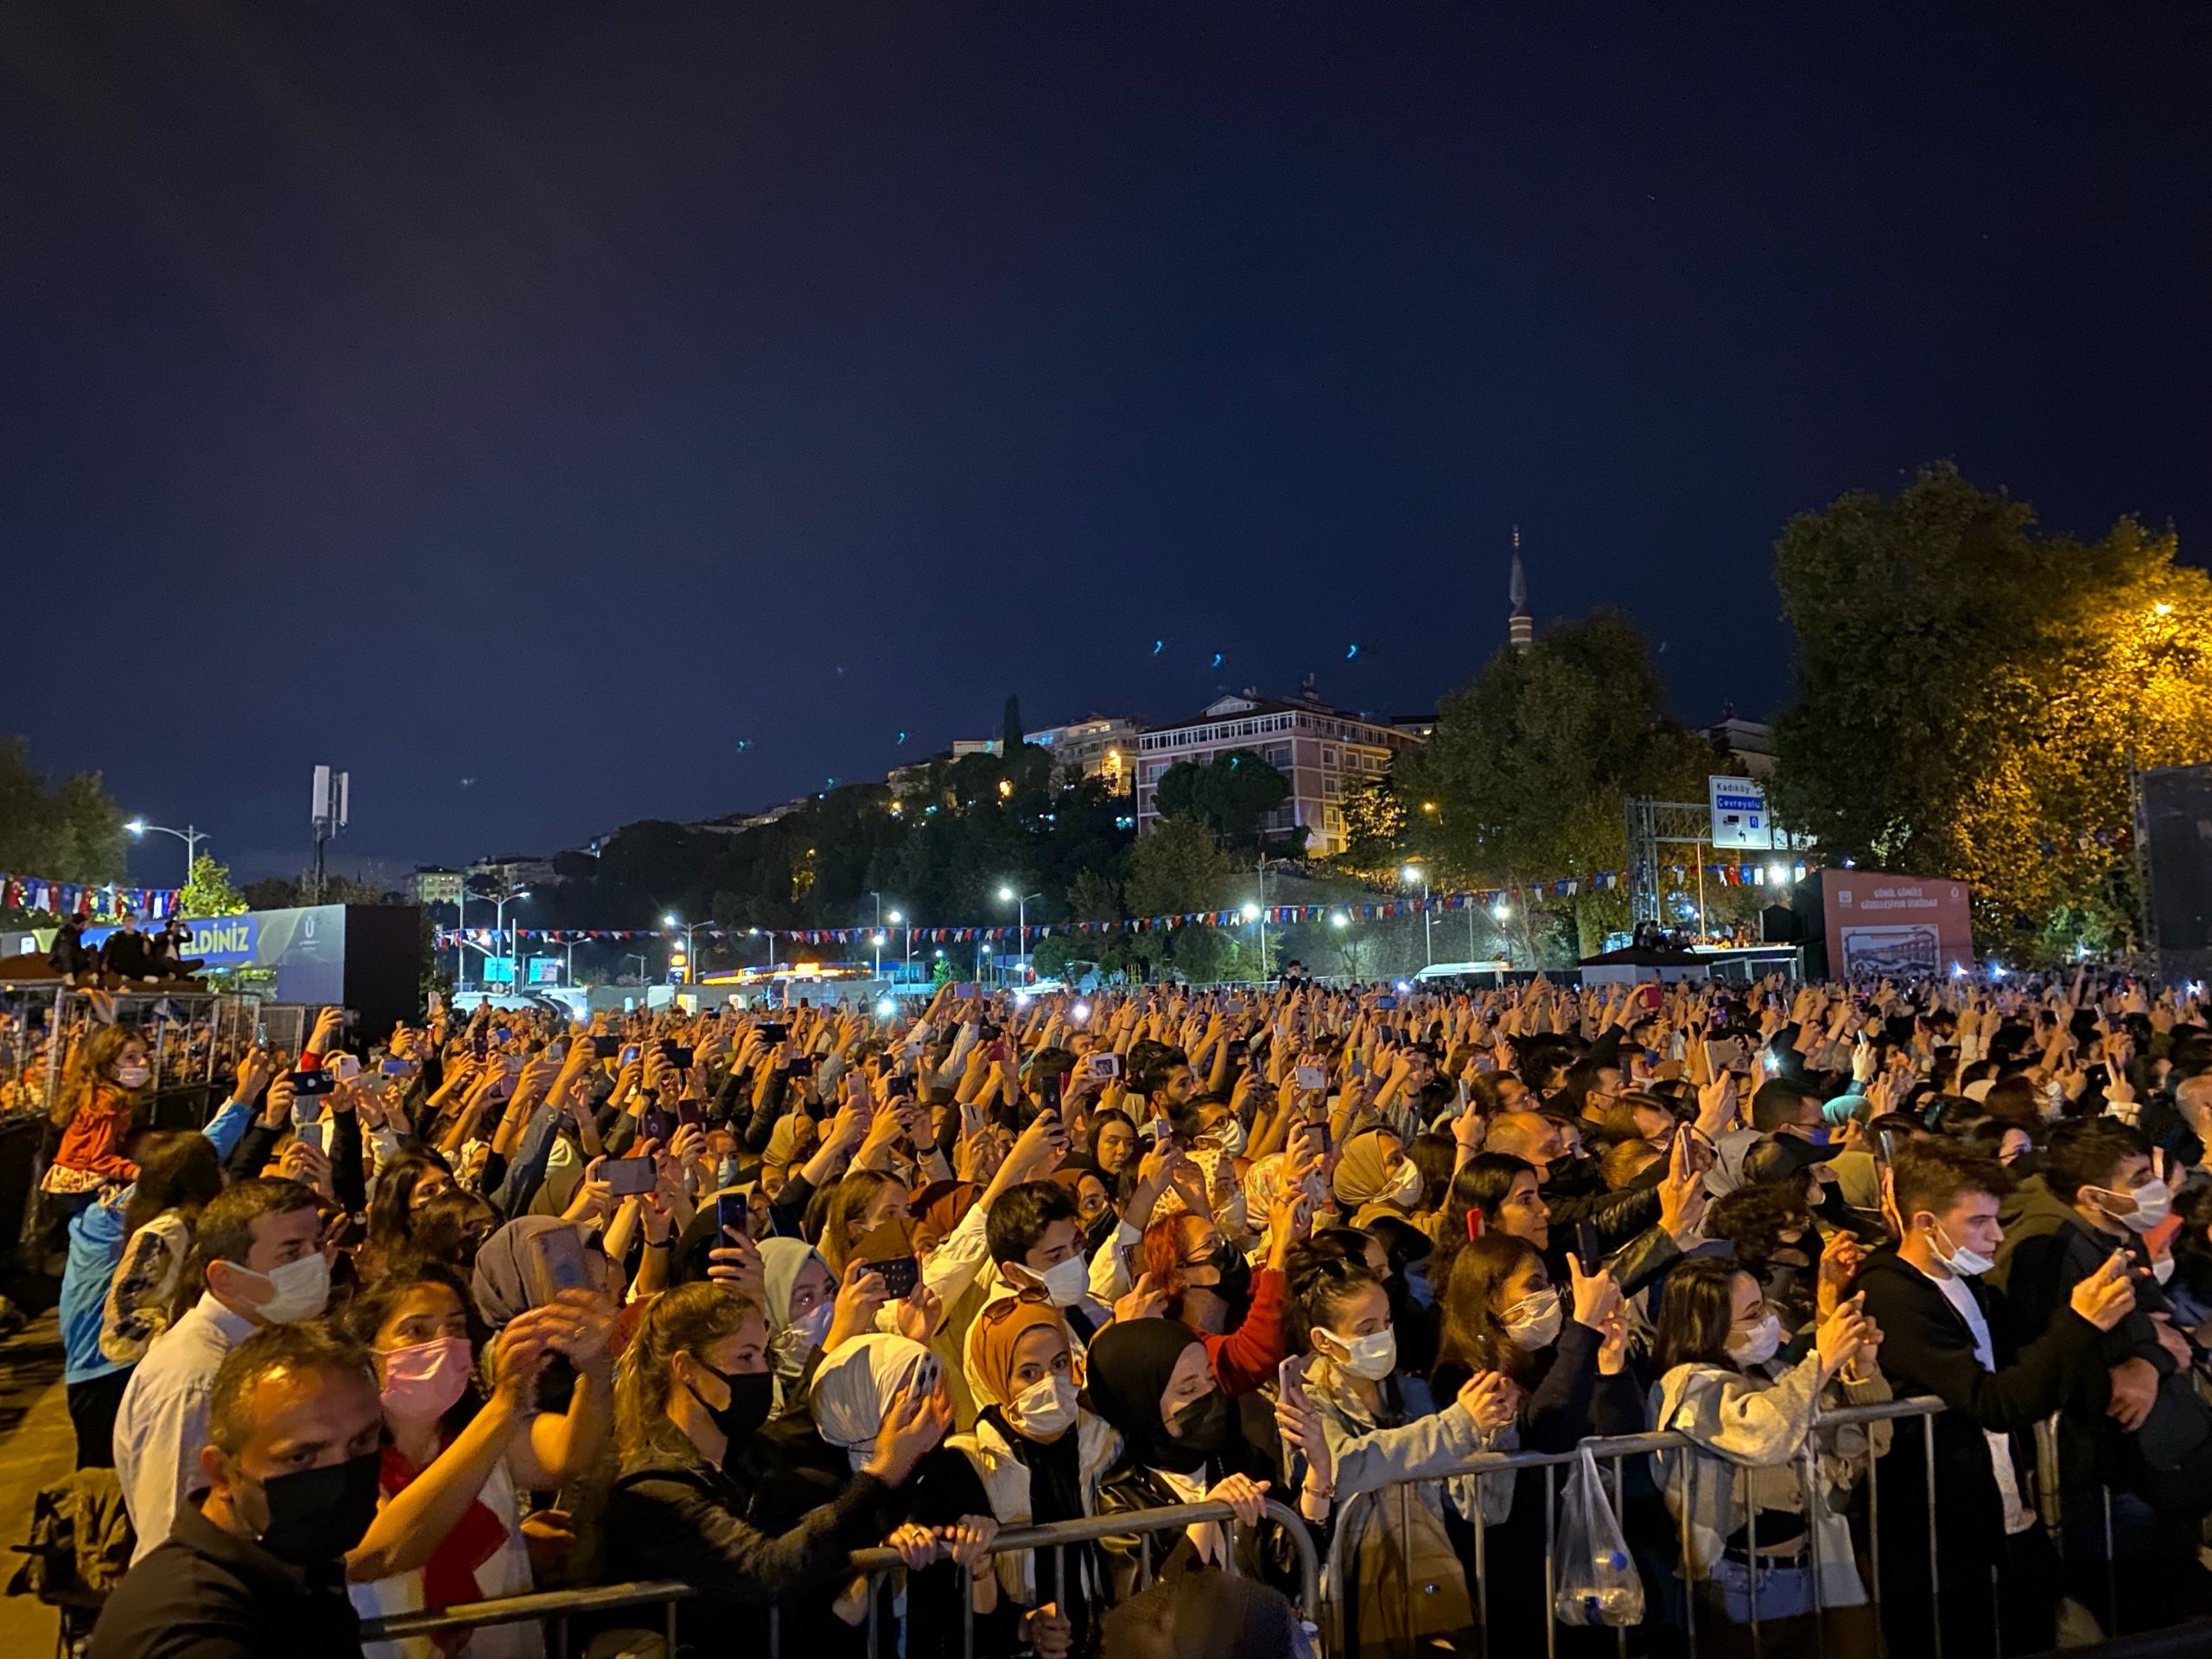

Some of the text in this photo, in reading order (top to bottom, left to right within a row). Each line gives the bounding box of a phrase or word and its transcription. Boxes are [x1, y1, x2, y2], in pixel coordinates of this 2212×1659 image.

[1717, 783, 1750, 794] Kadıköy
[1718, 798, 1760, 810] Çevreyolu
[179, 921, 249, 955] ELDİNİZ
